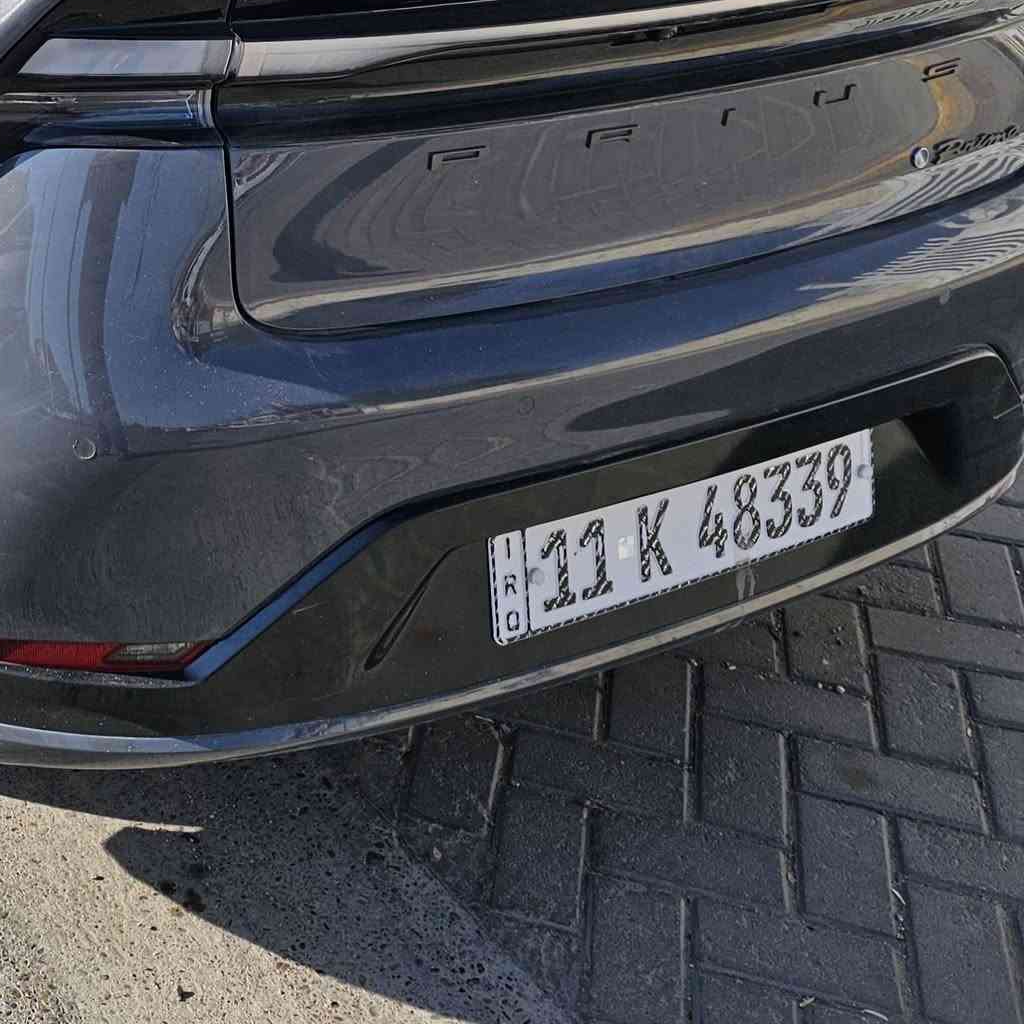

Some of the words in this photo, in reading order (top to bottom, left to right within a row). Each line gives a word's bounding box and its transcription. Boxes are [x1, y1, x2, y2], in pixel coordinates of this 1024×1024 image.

[540, 517, 613, 612] 11
[636, 498, 673, 582] K
[699, 443, 852, 559] 48339
